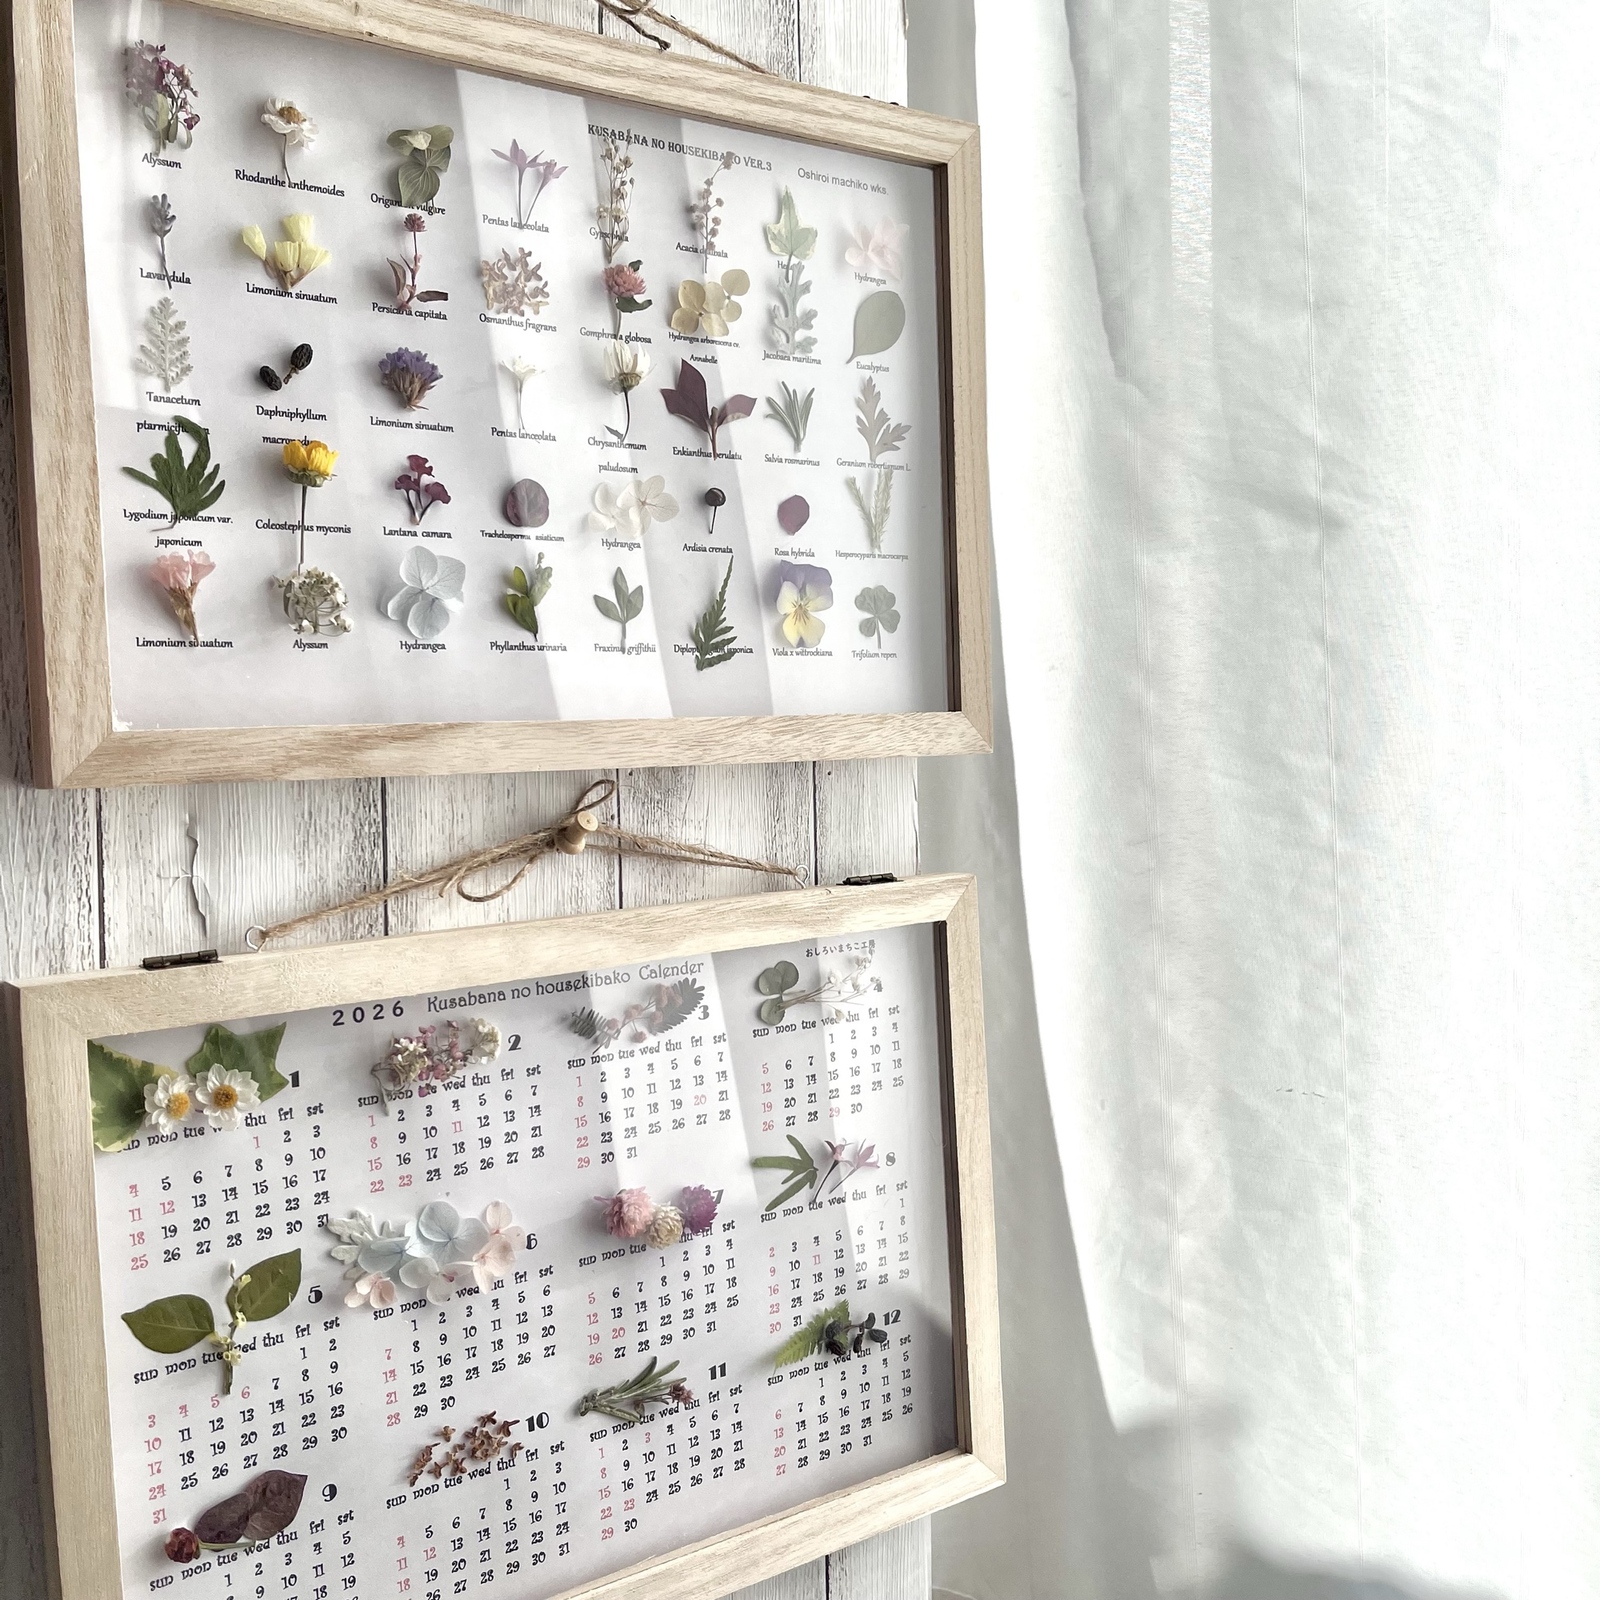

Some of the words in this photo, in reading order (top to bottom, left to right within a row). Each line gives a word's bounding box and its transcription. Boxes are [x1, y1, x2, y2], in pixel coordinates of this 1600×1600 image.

[142, 153, 182, 169] Alyssum
[652, 138, 665, 150] NO
[668, 142, 741, 164] HOUSEKIBAO
[744, 156, 772, 171] VER.3
[235, 169, 286, 188] Rhodanthe
[798, 168, 829, 183] Oshiroi
[832, 177, 868, 190] machiko
[482, 214, 508, 227] Pentas
[676, 242, 698, 254] Acacia
[854, 272, 887, 286] Hydrangea
[246, 283, 293, 299] Limonium
[295, 290, 338, 304] sinuatum
[415, 308, 448, 321] capitata
[480, 313, 523, 329] Osmanthus
[524, 319, 557, 333] fragrans
[625, 332, 652, 344] globosa
[669, 332, 699, 344] Hydrangea
[690, 354, 718, 364] Annabelle
[762, 350, 790, 362] Jacobaea
[792, 356, 822, 365] maritima
[856, 362, 890, 374] Eucalyptus
[146, 392, 201, 406] Tanacetum
[256, 405, 327, 422] Daphniphyllum
[370, 416, 413, 429] Limonium
[415, 422, 454, 432] sinuatum
[492, 427, 516, 438] Pentas
[588, 436, 647, 450] Chrysanthemum
[672, 447, 712, 458] Enkianthus
[764, 454, 783, 464] Salvia
[784, 457, 820, 467] rosmarinus
[836, 458, 866, 468] Geranium
[598, 462, 638, 474] paludosum
[123, 509, 168, 522] Lygodium
[316, 524, 350, 534] myconis
[383, 526, 418, 538] Lantana
[422, 530, 452, 539] camara
[155, 536, 202, 548] japonicum
[535, 534, 564, 542] asiaticum
[601, 538, 641, 552] Hydrangea
[682, 543, 707, 553] Ardisia
[708, 546, 733, 554] crenata
[774, 548, 790, 556] Rosa
[791, 548, 815, 559] hybrida
[136, 637, 186, 648] Limonium
[293, 640, 328, 652] Alyssum
[400, 640, 446, 653] Hydrangea
[490, 641, 536, 653] Phyllanthus
[538, 643, 568, 652] urinaria
[627, 643, 656, 656] griffithii
[772, 648, 788, 656] Viola
[852, 650, 880, 661] Trifolium
[333, 1000, 404, 1026] 2026
[427, 991, 506, 1013] Kusabana
[511, 986, 530, 999] no
[536, 970, 630, 996] housekibako
[639, 961, 704, 980] Calender
[698, 1005, 709, 1020] 3
[868, 1008, 878, 1018] fri
[888, 1005, 900, 1016] sat
[508, 1034, 522, 1052] 2
[639, 1041, 660, 1055] wed
[665, 1039, 682, 1051] thu
[691, 1036, 702, 1048] fri
[713, 1032, 726, 1044] sat
[289, 1071, 299, 1088] 1
[442, 1077, 466, 1092] wed
[472, 1074, 491, 1086] thu
[501, 1068, 514, 1081] fri
[526, 1064, 541, 1077] sat
[245, 1113, 266, 1128] thu
[278, 1107, 294, 1121] fri
[306, 1102, 324, 1117] sat
[886, 1152, 896, 1166] 8
[128, 1208, 142, 1222] 11
[160, 1200, 175, 1215] 12
[191, 1194, 206, 1208] 13
[222, 1186, 238, 1202] 14
[252, 1179, 268, 1196] 15
[282, 1174, 298, 1191] 16
[312, 1169, 326, 1184] 17
[852, 1190, 867, 1200] thu
[876, 1185, 886, 1196] fri
[896, 1180, 908, 1191] sat
[526, 1234, 538, 1249] 6
[512, 1271, 528, 1284] fri
[539, 1264, 554, 1278] sat
[307, 1285, 323, 1304] 5
[587, 1312, 598, 1326] 12
[611, 1306, 622, 1320] 13
[634, 1300, 648, 1315] 14
[658, 1294, 671, 1308] 15
[681, 1288, 693, 1302] 16
[705, 1283, 715, 1294] 17
[726, 1276, 737, 1289] 18
[883, 1310, 901, 1326] 12
[263, 1333, 284, 1348] thu
[295, 1324, 311, 1340] fri
[323, 1316, 340, 1332] sat
[709, 1362, 727, 1380] 11
[708, 1391, 720, 1403] fri
[730, 1384, 742, 1397] sat
[526, 1412, 549, 1432] 10
[148, 1461, 162, 1476] 17
[179, 1450, 194, 1467] 18
[210, 1441, 226, 1458] 19
[241, 1430, 258, 1447] 20
[272, 1422, 287, 1437] 21
[301, 1412, 316, 1428] 22
[330, 1404, 345, 1418] 23
[468, 1462, 491, 1480] wed
[526, 1449, 538, 1462] fri
[550, 1440, 565, 1455] sat
[798, 1456, 808, 1468] 28
[819, 1449, 830, 1461] 29
[840, 1442, 852, 1454] 30
[322, 1484, 337, 1502] 9
[276, 1531, 297, 1546] thu
[309, 1519, 325, 1536] fri
[338, 1510, 354, 1525] sat
